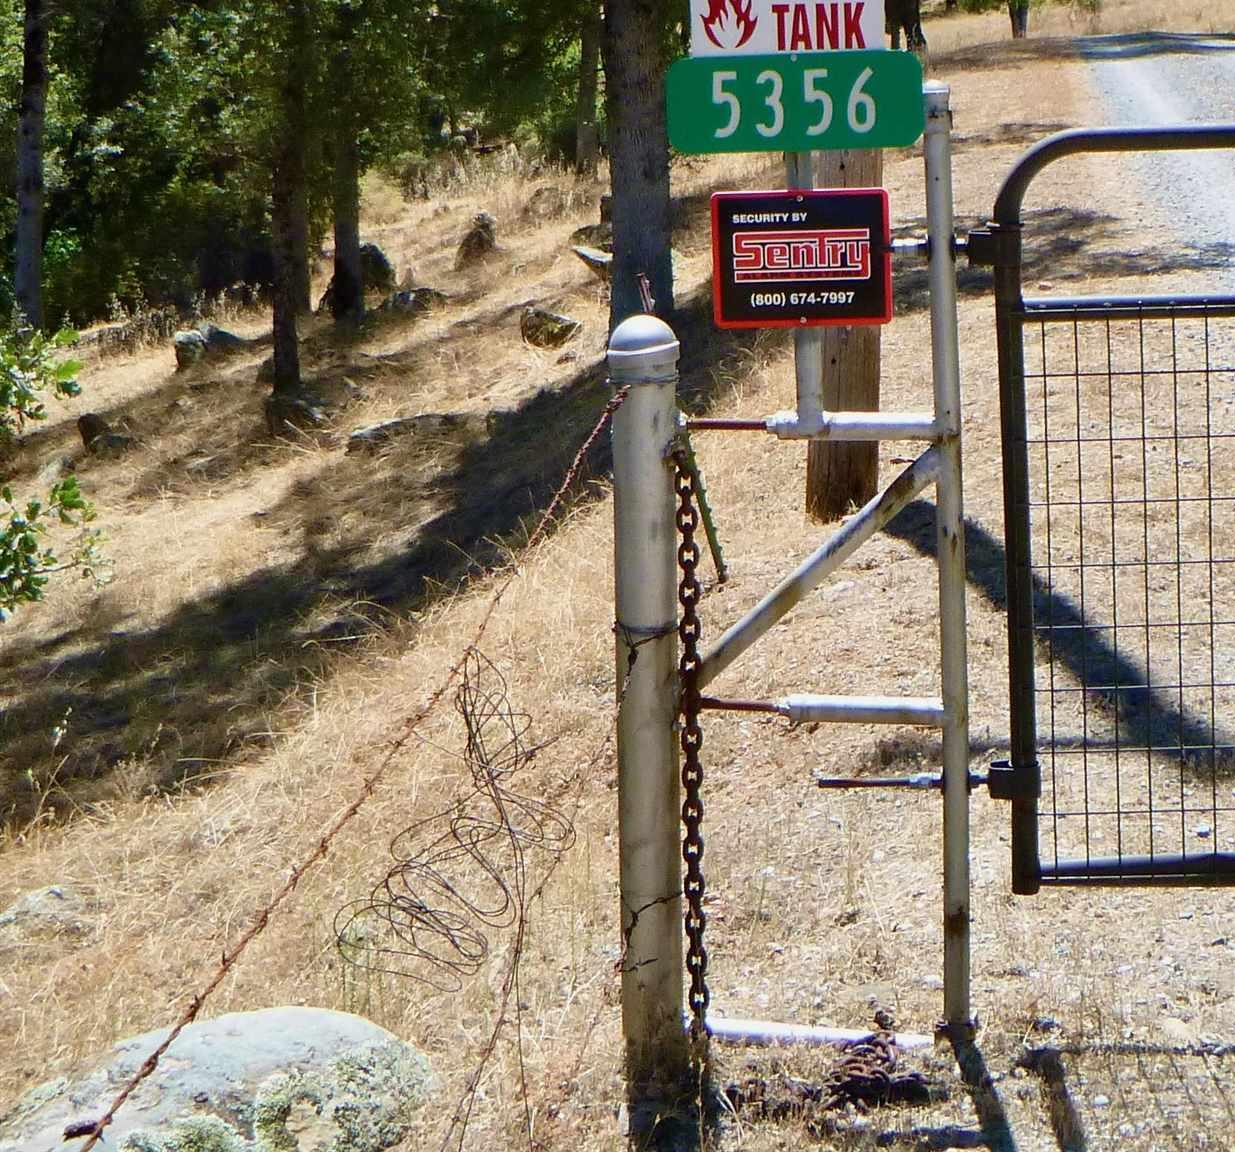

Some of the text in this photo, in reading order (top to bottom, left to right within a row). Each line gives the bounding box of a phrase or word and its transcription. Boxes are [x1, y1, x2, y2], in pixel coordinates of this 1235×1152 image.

[771, 1, 866, 51] TANK
[711, 66, 877, 139] 5356
[732, 212, 808, 224] SECURITY BY
[750, 291, 855, 307] (800) 674-7997
